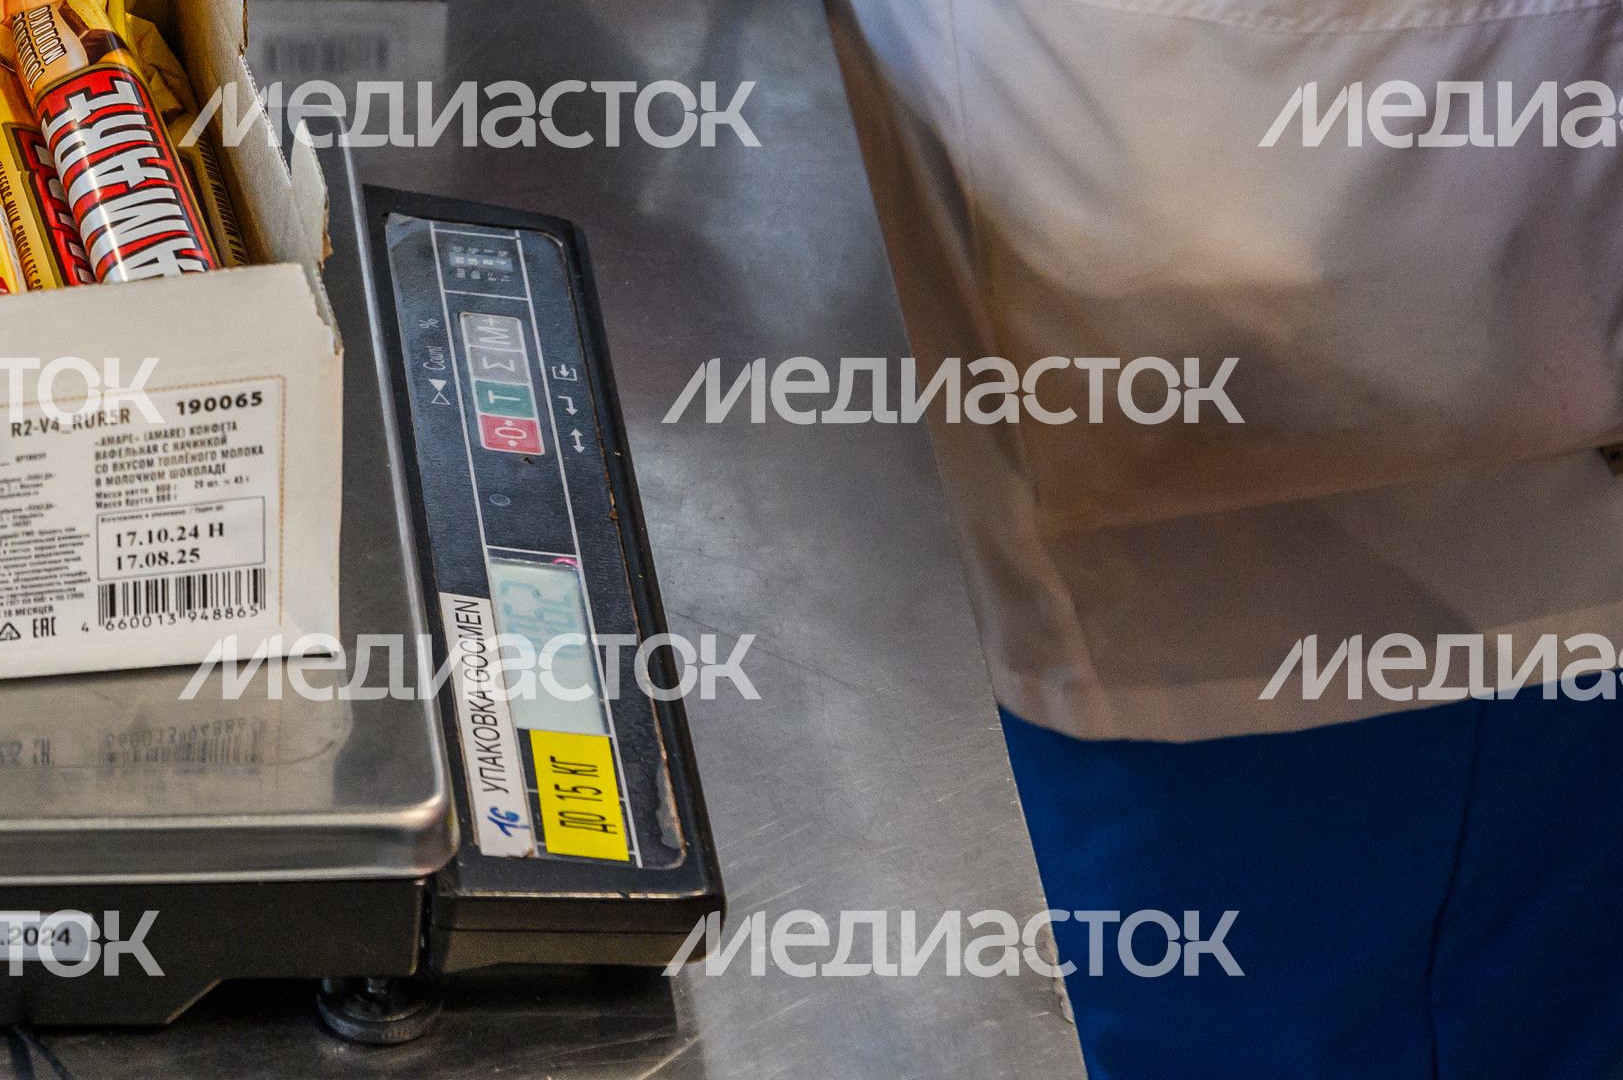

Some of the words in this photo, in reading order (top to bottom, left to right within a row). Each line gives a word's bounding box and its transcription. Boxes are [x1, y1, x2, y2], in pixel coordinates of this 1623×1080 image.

[28, 4, 68, 67] МОЛОКО
[176, 390, 264, 417] 190065
[189, 421, 238, 436] КОНФЕТА
[94, 445, 159, 462] ВАФЕЛЬНАЯ
[172, 435, 228, 452] НАЧИНКОЙ
[94, 463, 109, 475] СО
[112, 458, 154, 473] ВКУСОМ
[221, 445, 264, 459] МОЛОКА
[106, 471, 166, 487] МОЛОЧНОМ
[169, 463, 226, 479] ШОКОЛАДЕ
[115, 524, 200, 548] 17.10.24
[115, 548, 201, 571] 17.08.25
[105, 612, 177, 632] 660013
[188, 604, 260, 622] 948865
[468, 688, 510, 794] УПАКОВКА
[549, 755, 600, 778] КГ
[554, 783, 603, 803] 15
[558, 810, 617, 835] ДО
